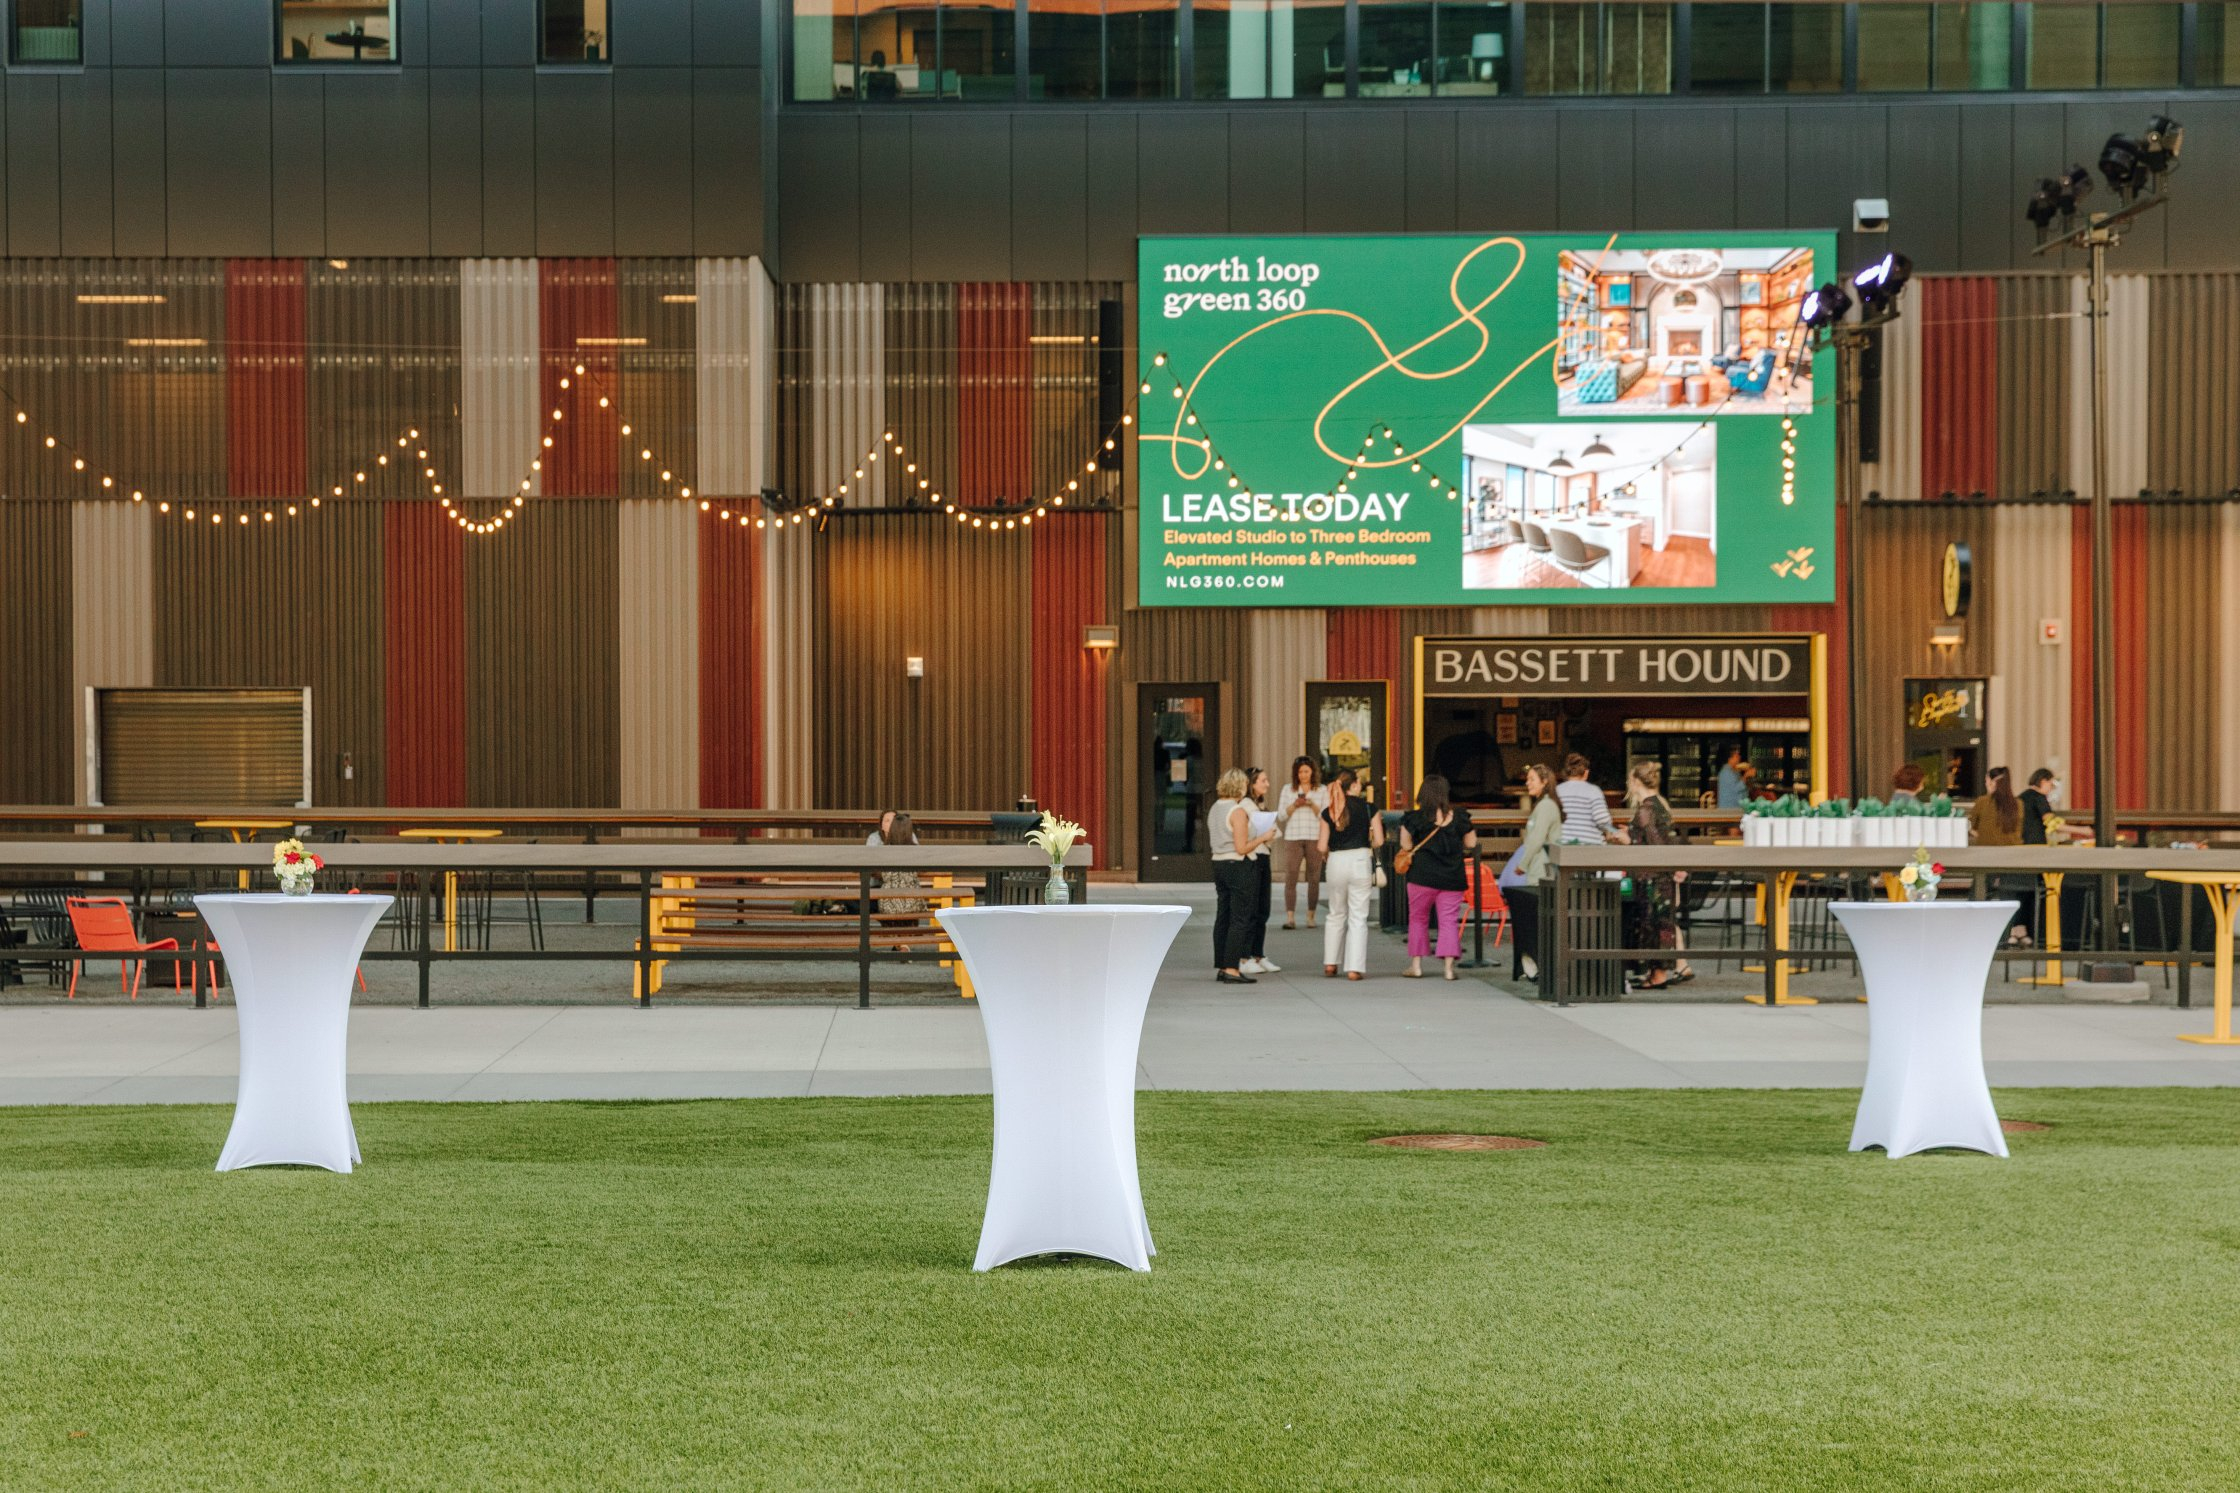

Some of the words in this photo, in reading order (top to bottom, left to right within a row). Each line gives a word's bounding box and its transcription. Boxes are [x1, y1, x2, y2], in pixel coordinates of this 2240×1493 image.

[1163, 256, 1250, 282] north
[1256, 256, 1320, 287] loop
[1163, 293, 1251, 319] green
[1256, 289, 1306, 311] 360
[1163, 494, 1273, 522] LEASE
[1281, 493, 1410, 521] TODAY
[1164, 530, 1233, 544] Elevated
[1236, 530, 1287, 544] Studio
[1290, 531, 1307, 543] to
[1310, 529, 1355, 543] Three
[1358, 529, 1431, 543] Bedroom
[1163, 552, 1247, 568] Apartment
[1251, 552, 1306, 566] Homes
[1309, 551, 1322, 566] &
[1325, 551, 1417, 566] Penthouses
[1166, 575, 1284, 588] NLG360.COM
[1435, 649, 1624, 683] BASSETT
[1639, 648, 1792, 683] HOUND
